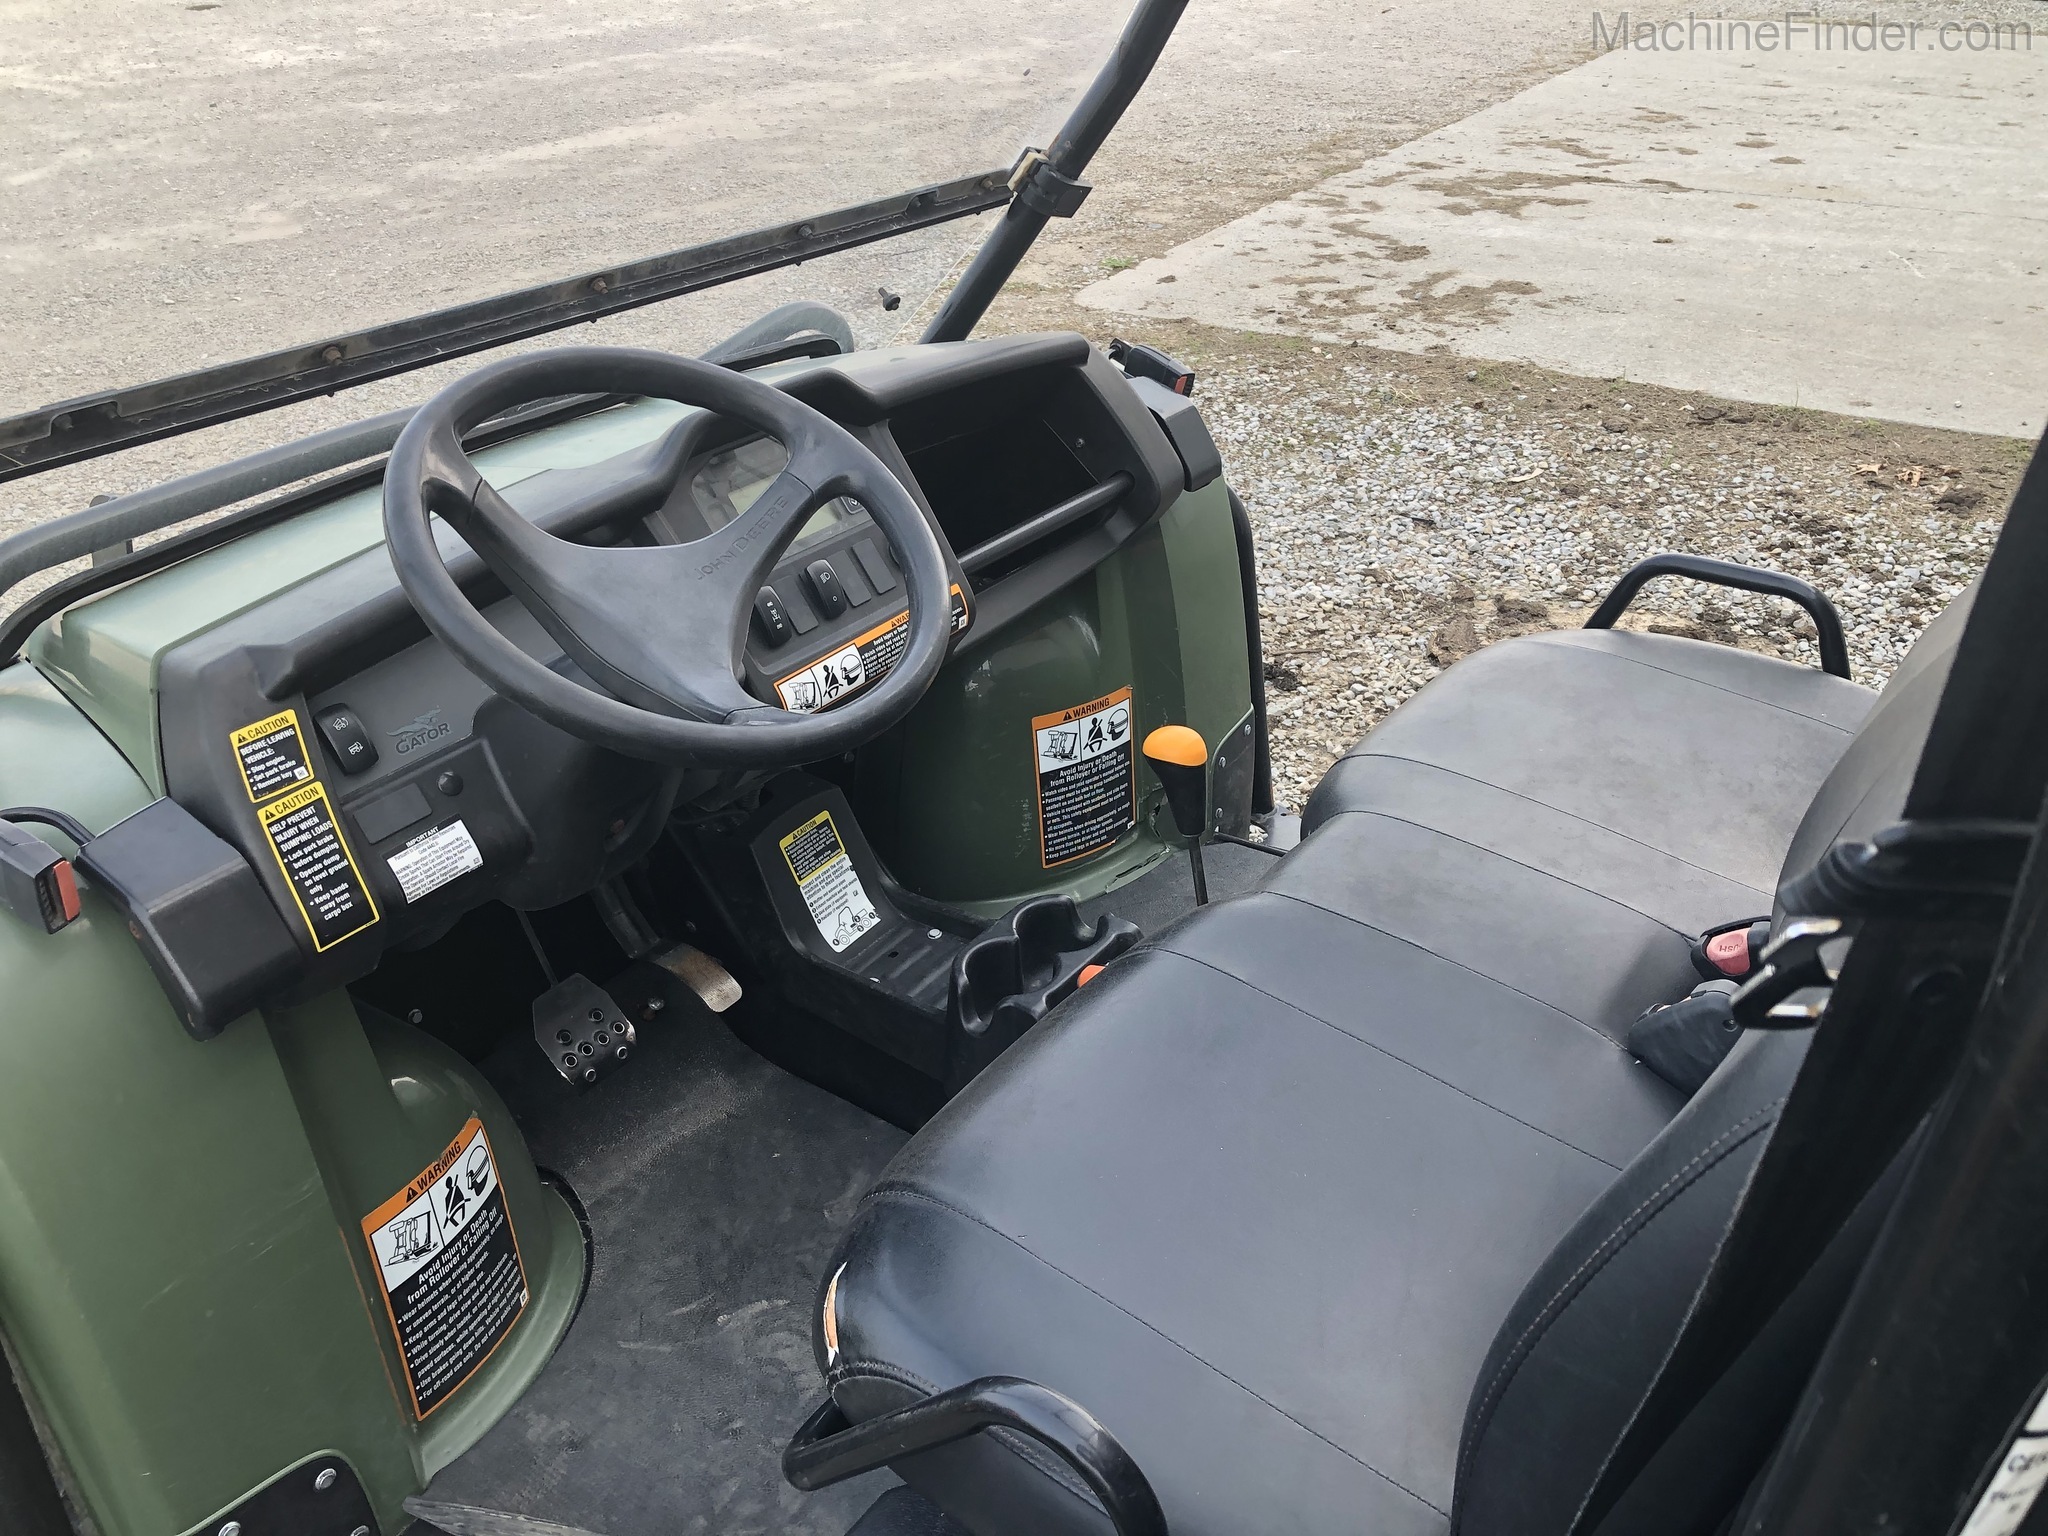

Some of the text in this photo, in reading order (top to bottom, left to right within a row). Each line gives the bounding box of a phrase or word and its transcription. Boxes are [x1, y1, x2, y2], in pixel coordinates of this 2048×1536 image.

[694, 496, 789, 580] JOHN DEERE
[1072, 697, 1110, 718] WARNING
[247, 715, 289, 739] CAUTION
[395, 722, 450, 754] GATOR
[239, 728, 295, 756] BEFORE LEAVING
[250, 755, 286, 773] Stop engine
[253, 759, 296, 781] Set park brake
[1050, 778, 1065, 787] from
[1066, 769, 1091, 782] Rollover
[1091, 766, 1098, 774] or
[1098, 758, 1117, 771] Falling
[1059, 766, 1077, 777] Avoid
[1077, 761, 1094, 772] Injury
[1101, 750, 1117, 762] Death
[256, 770, 293, 789] Remove key
[274, 786, 319, 814] CAUTION
[268, 805, 316, 834] HELP PREVENT
[274, 815, 320, 843] INJURY WHEN
[796, 819, 817, 836] CAUTION
[280, 820, 333, 852] DUMPING LOADS
[287, 833, 334, 861] Lock park brake
[405, 825, 439, 848] IMPORTANT
[292, 841, 339, 869] before dumping
[298, 853, 340, 878] Operate dump
[304, 858, 349, 887] on level ground
[309, 883, 323, 895] only
[313, 882, 349, 904] Keep hands
[319, 892, 350, 912] away from
[323, 901, 353, 920] cargo box
[416, 1140, 461, 1191] WARNING
[407, 1206, 497, 1304] from Rollover or Falling Off
[418, 1209, 487, 1285] Avoid Injury or Death
[401, 1307, 417, 1322] Wear
[417, 1289, 439, 1310] helmets
[438, 1277, 452, 1292] when
[451, 1261, 467, 1280] driving
[408, 1330, 423, 1344] Keep
[423, 1318, 437, 1333] arms
[437, 1308, 447, 1321] and
[446, 1299, 458, 1312] legs
[457, 1293, 463, 1302] in
[462, 1279, 477, 1296] during
